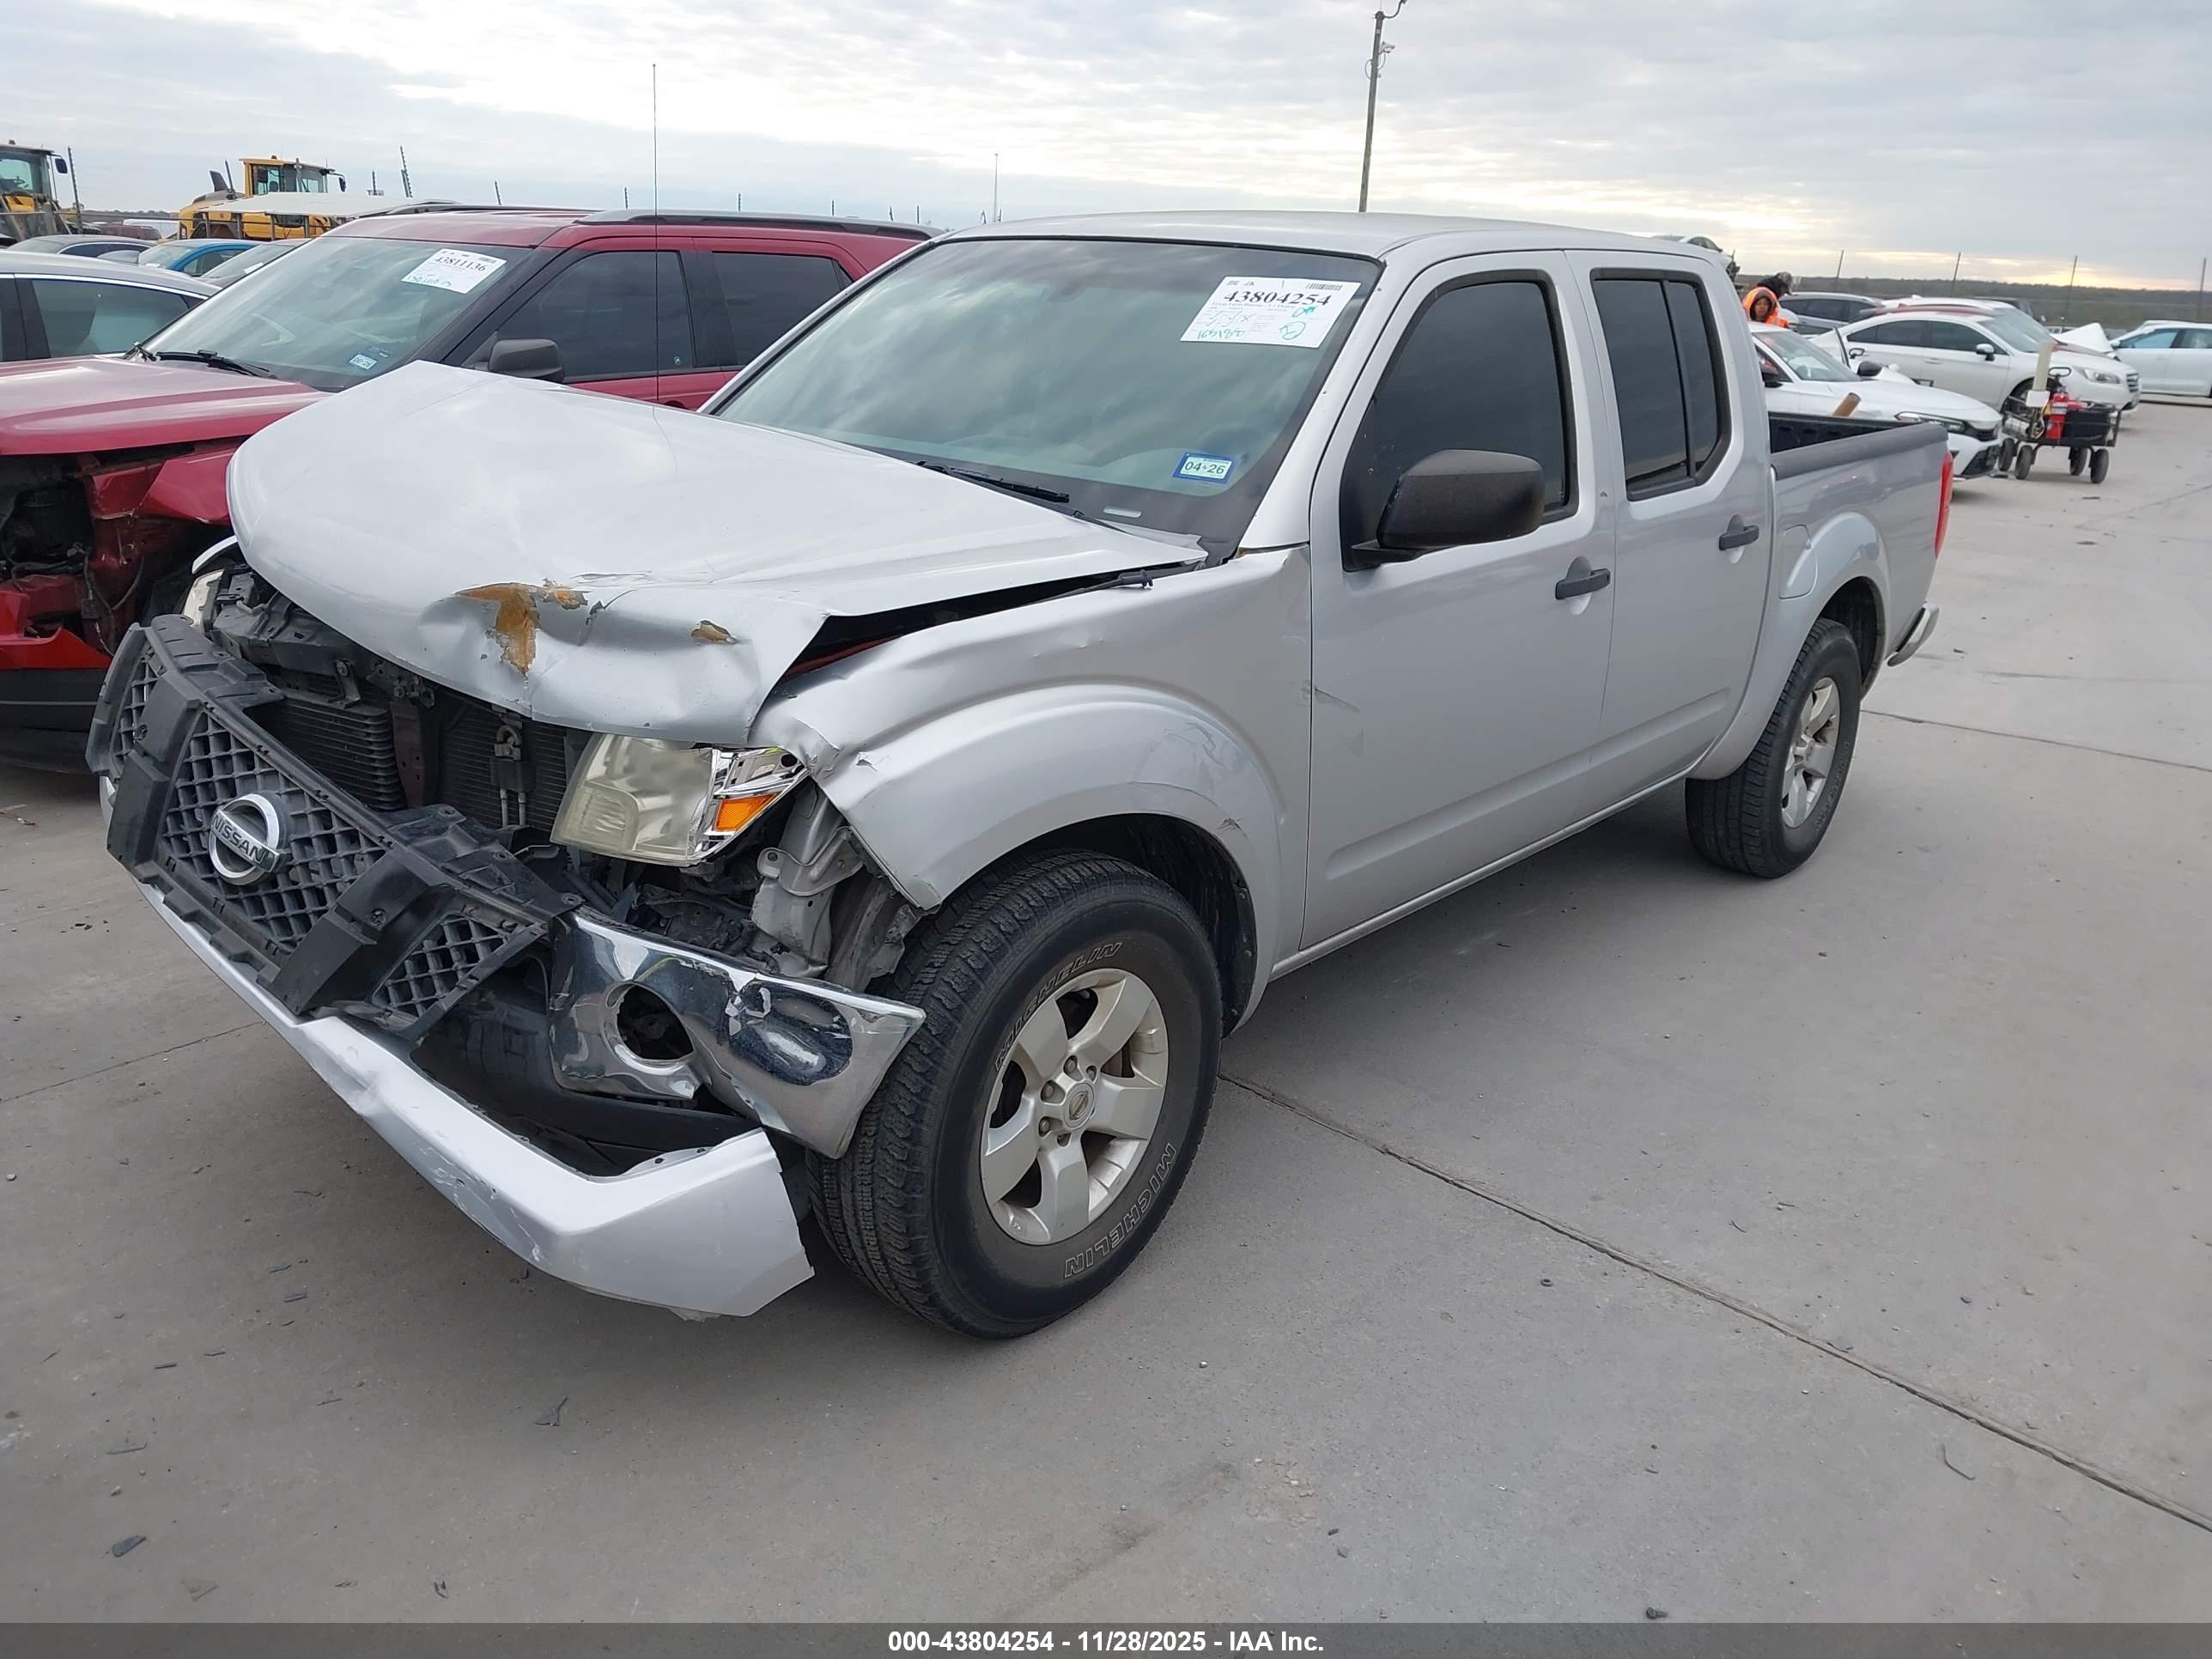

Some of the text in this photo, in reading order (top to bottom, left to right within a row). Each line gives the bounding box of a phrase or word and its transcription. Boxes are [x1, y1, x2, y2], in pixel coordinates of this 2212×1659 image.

[1223, 290, 1332, 306] 43804254
[211, 813, 269, 862] NISSAN
[994, 941, 1123, 1072] MICHELIN
[1064, 1142, 1177, 1279] MICHELIN
